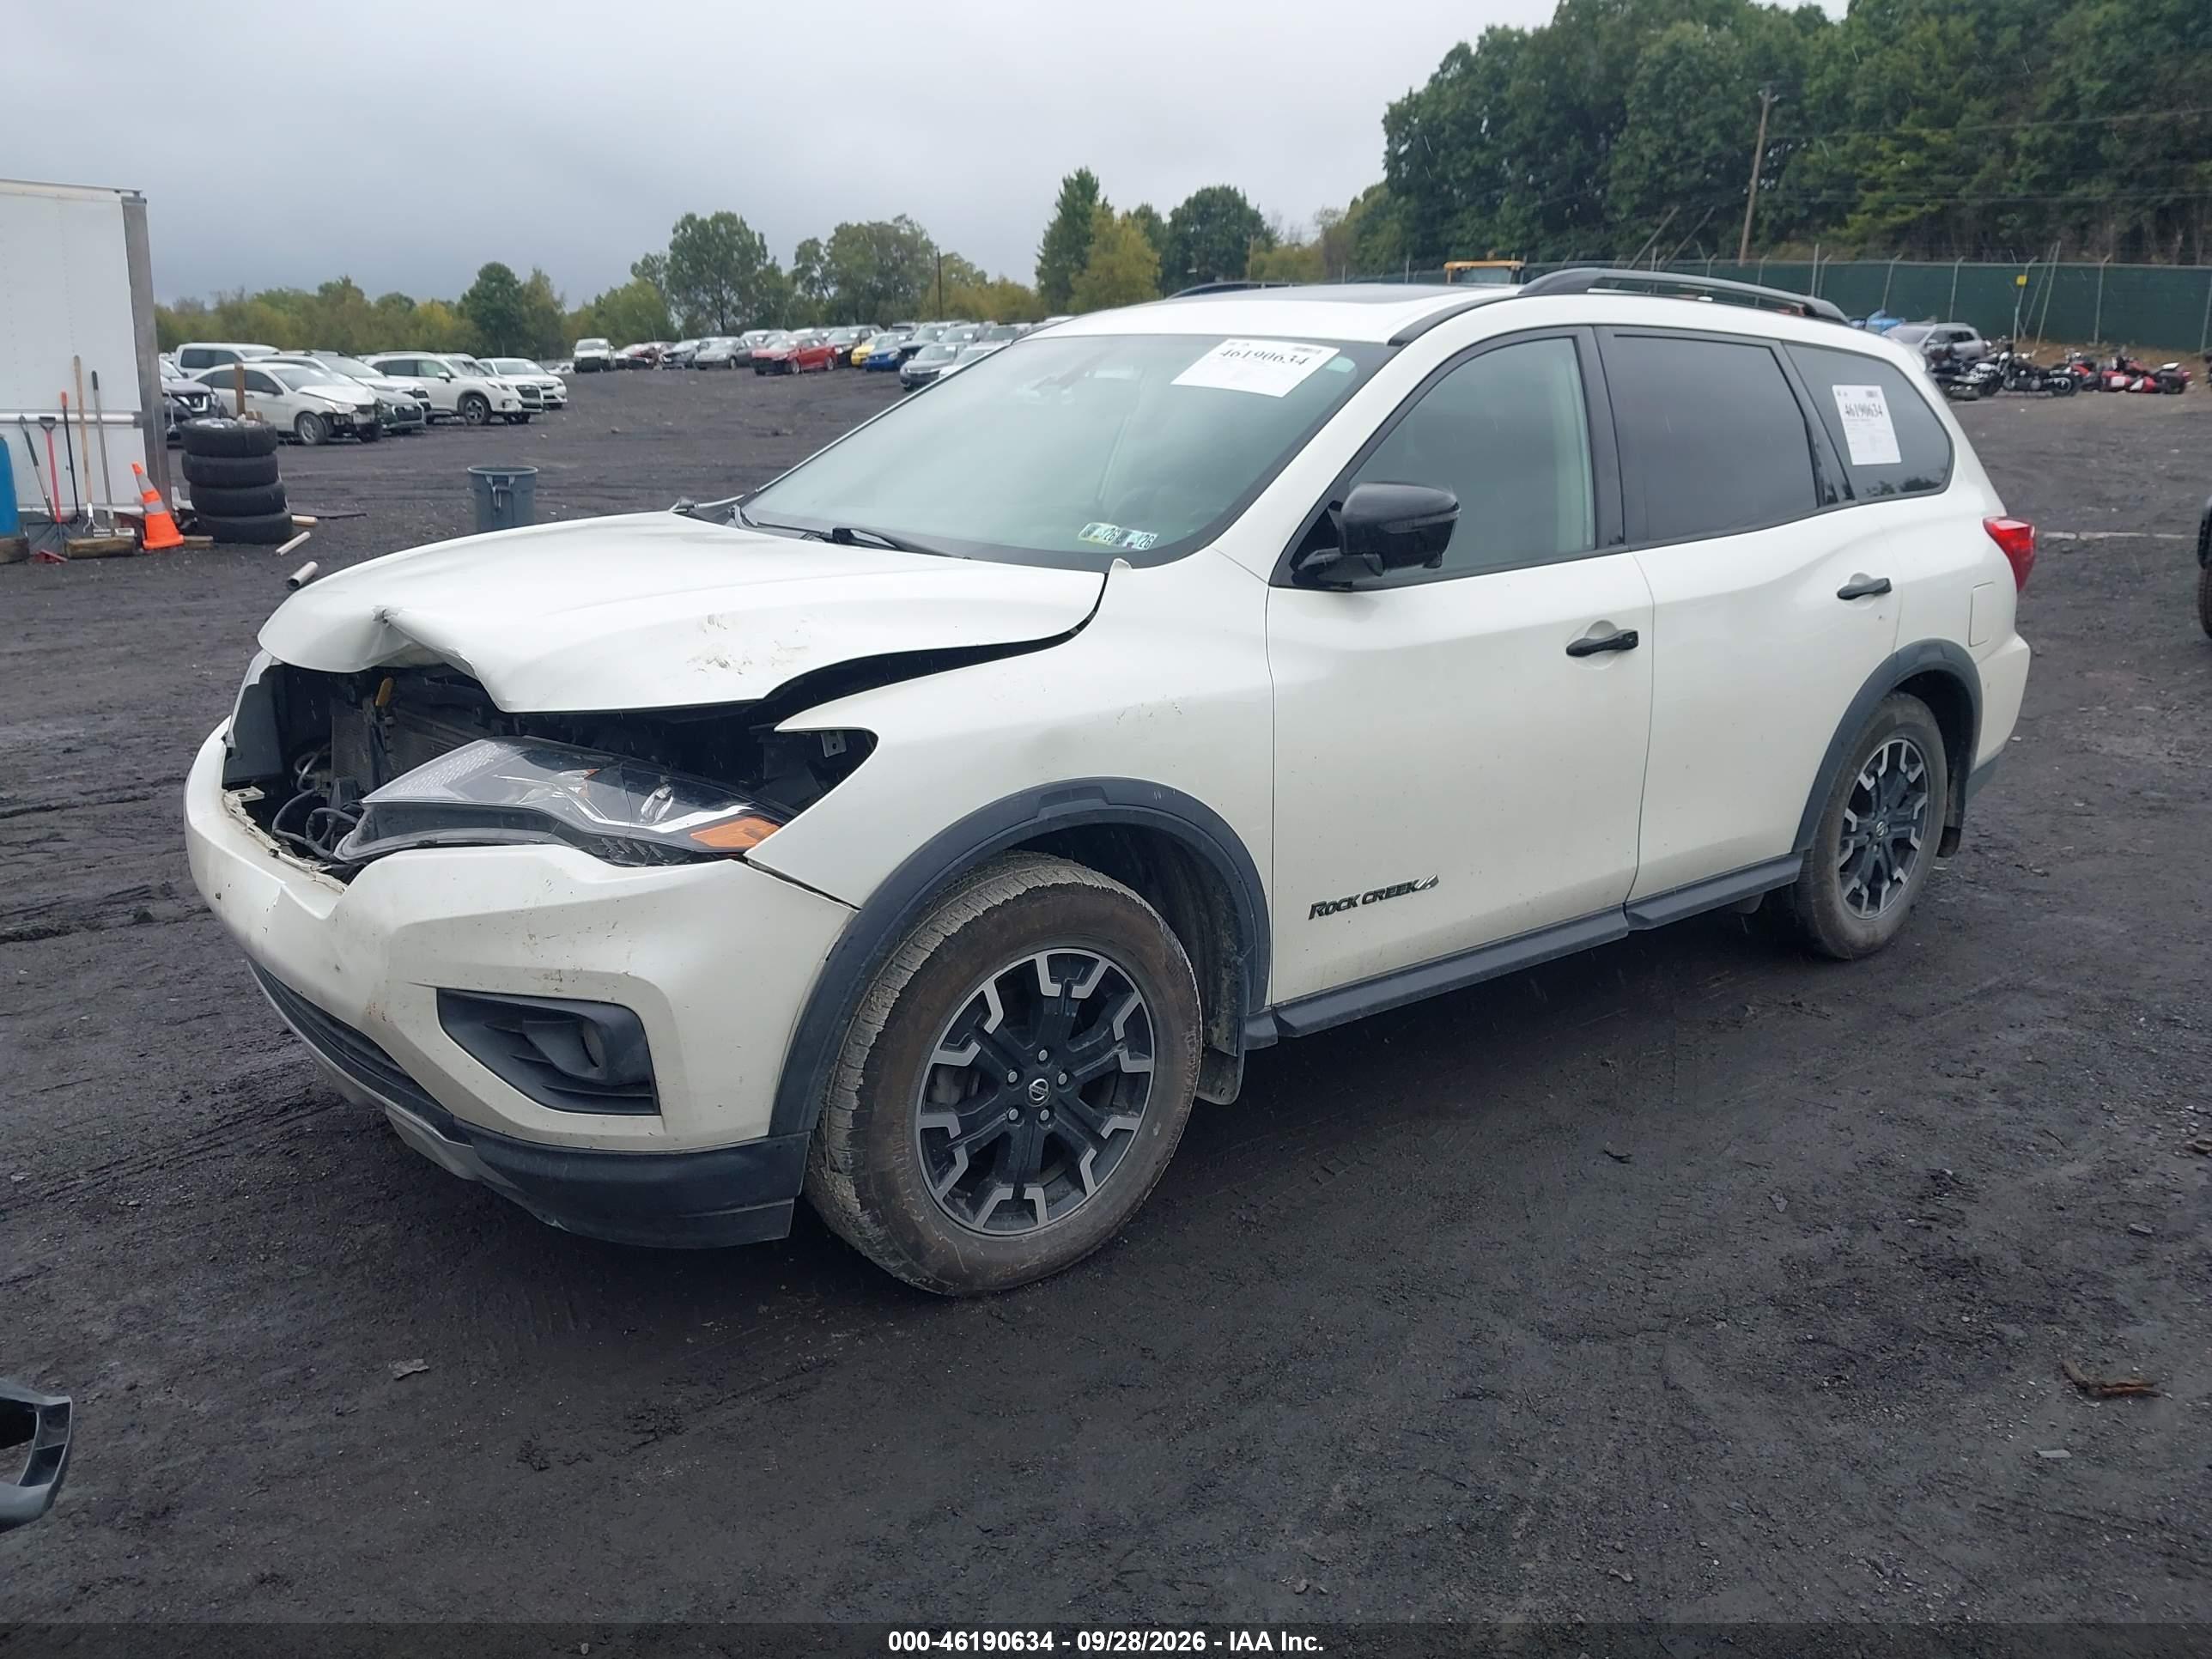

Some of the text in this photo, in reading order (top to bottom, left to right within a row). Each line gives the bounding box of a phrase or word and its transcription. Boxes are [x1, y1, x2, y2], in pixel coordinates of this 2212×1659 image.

[1219, 349, 1310, 367] 46190634
[1103, 527, 1121, 542] 26
[1139, 534, 1155, 549] 26
[1308, 879, 1419, 920] ROCK CREEK
